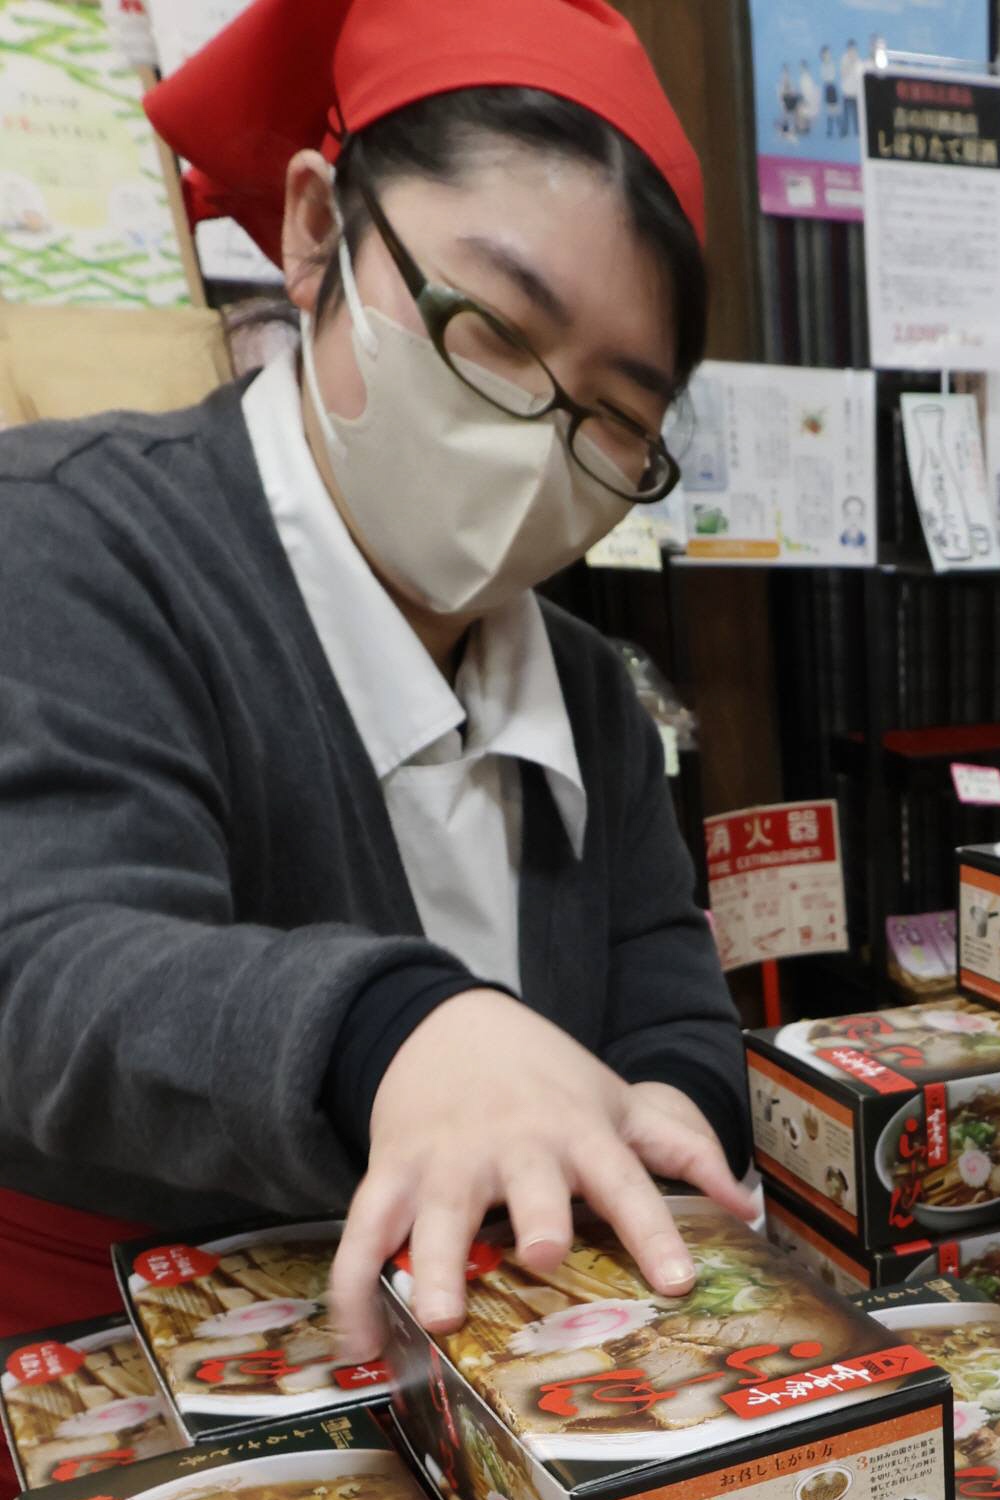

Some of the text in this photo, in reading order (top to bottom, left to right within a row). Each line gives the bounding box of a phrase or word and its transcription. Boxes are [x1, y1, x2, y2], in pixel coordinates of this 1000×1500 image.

[537, 1342, 822, 1414] らーめん
[748, 1365, 870, 1404] 喜多方
[856, 1454, 868, 1470] 3
